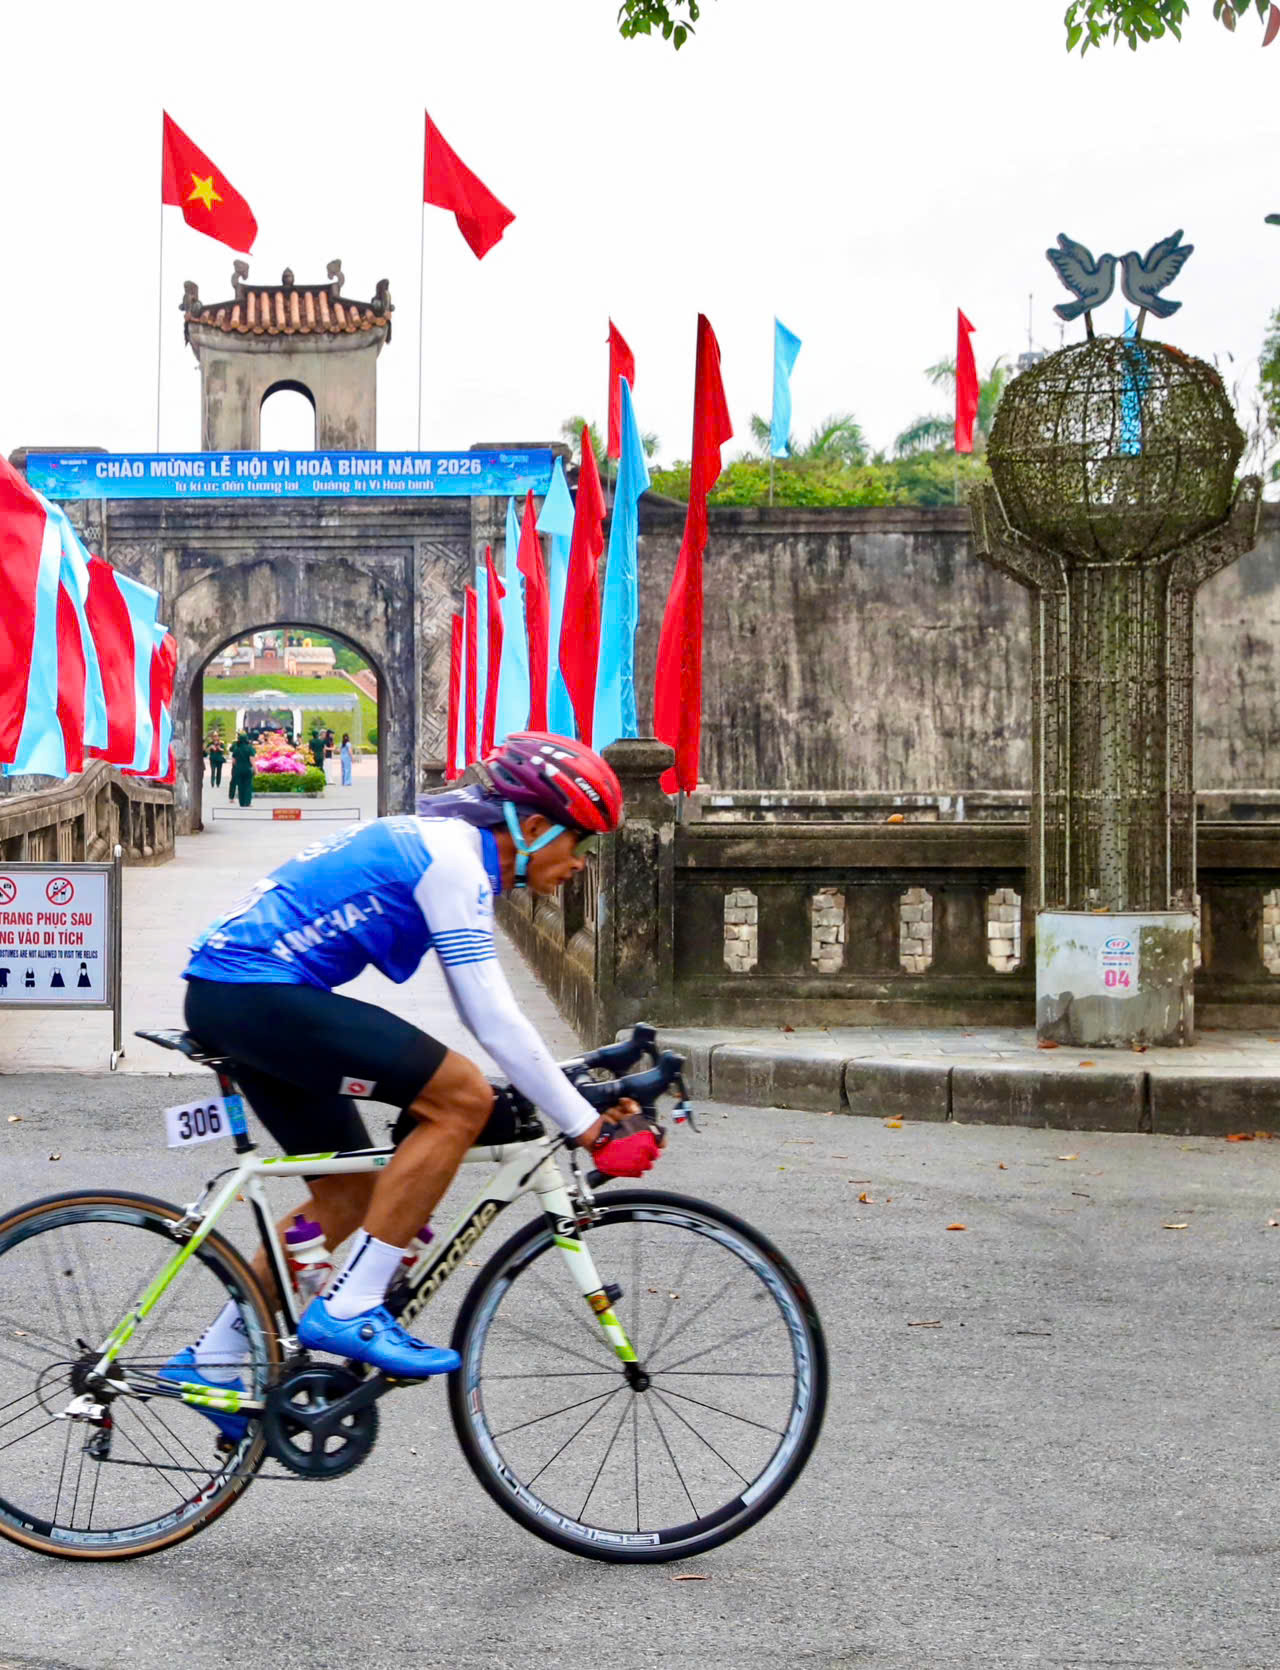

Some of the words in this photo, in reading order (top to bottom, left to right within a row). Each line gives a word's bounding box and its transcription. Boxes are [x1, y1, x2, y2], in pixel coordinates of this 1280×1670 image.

[95, 458, 145, 478] CHÀO
[150, 458, 205, 477] MỪNG
[210, 456, 231, 477] LỄ
[236, 457, 268, 480] HỘI
[273, 456, 290, 477] VÌ
[296, 455, 333, 476] HOÀ
[338, 455, 383, 476] BÌNH
[388, 455, 432, 476] NĂM
[436, 458, 482, 476] 2026
[37, 912, 67, 929] PHỤC
[70, 912, 93, 926] SAU
[18, 929, 40, 945] VÀO
[43, 932, 55, 945] DI
[59, 928, 84, 945] TÍCH
[20, 949, 28, 959] ARE
[28, 949, 37, 959] NOT
[37, 949, 57, 959] ALLOWED
[75, 949, 83, 959] THE
[1104, 969, 1131, 988] 04
[178, 1104, 222, 1140] 306
